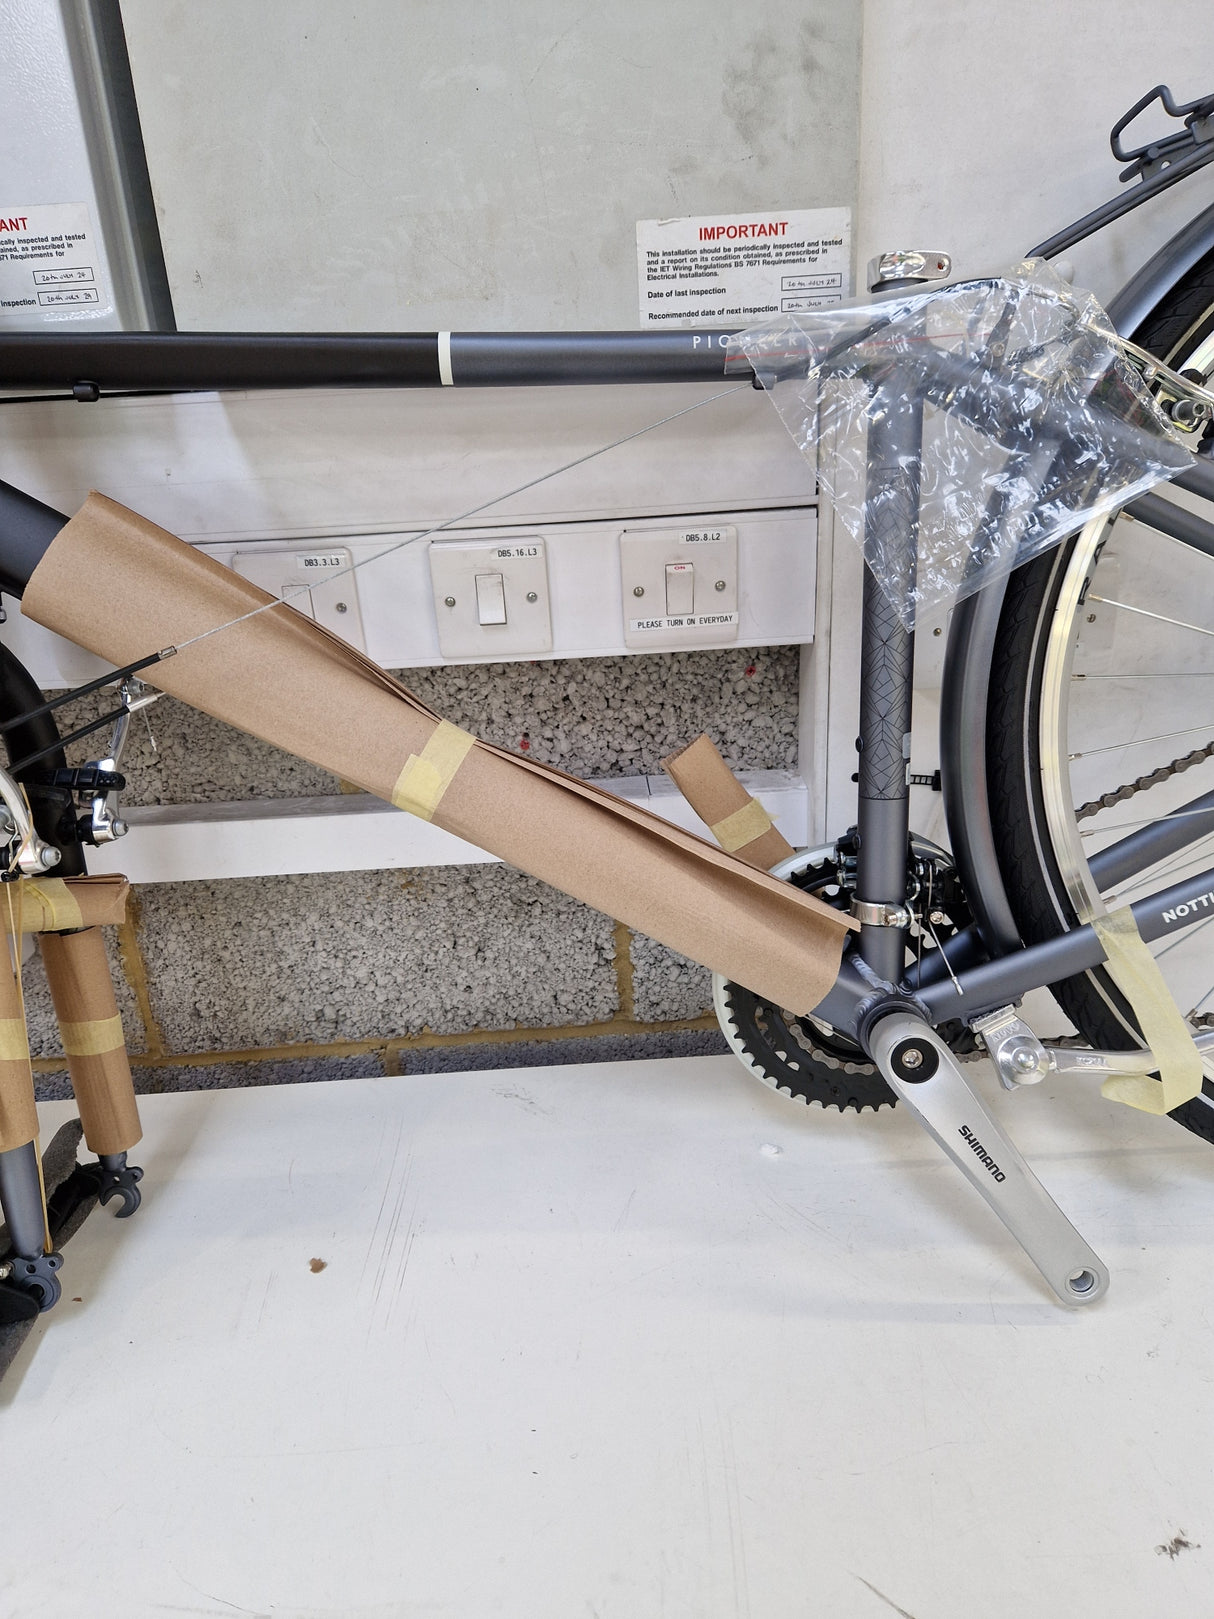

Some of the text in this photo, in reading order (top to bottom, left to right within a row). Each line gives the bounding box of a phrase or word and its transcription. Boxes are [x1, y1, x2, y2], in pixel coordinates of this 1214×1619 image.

[699, 222, 788, 241] IMPORTANT
[17, 236, 48, 244] inspected
[31, 243, 65, 252] prescribed
[700, 246, 720, 254] should
[734, 244, 770, 253] periodically
[773, 242, 805, 250] inspected
[807, 240, 819, 248] and
[10, 252, 53, 260] Requirements
[667, 258, 687, 266] report
[711, 254, 740, 262] condition
[743, 252, 772, 260] obtained,
[785, 248, 819, 258] prescribed
[673, 264, 692, 272] Wiring
[695, 262, 732, 271] Regulations
[762, 258, 806, 266] Requirements
[666, 290, 673, 298] of
[690, 288, 726, 296] inspection
[1, 299, 36, 308] inspection
[648, 310, 699, 320] Recommended
[743, 305, 778, 314] inspection
[686, 533, 721, 542] DB5.8.L2
[497, 548, 537, 557] DB5.16.L3
[304, 558, 340, 567] DB3.3.L3
[637, 621, 662, 629] PLEASE
[667, 619, 683, 627] TURN
[700, 616, 733, 624] EVERYDAY
[958, 1125, 1006, 1183] SHIMANO
